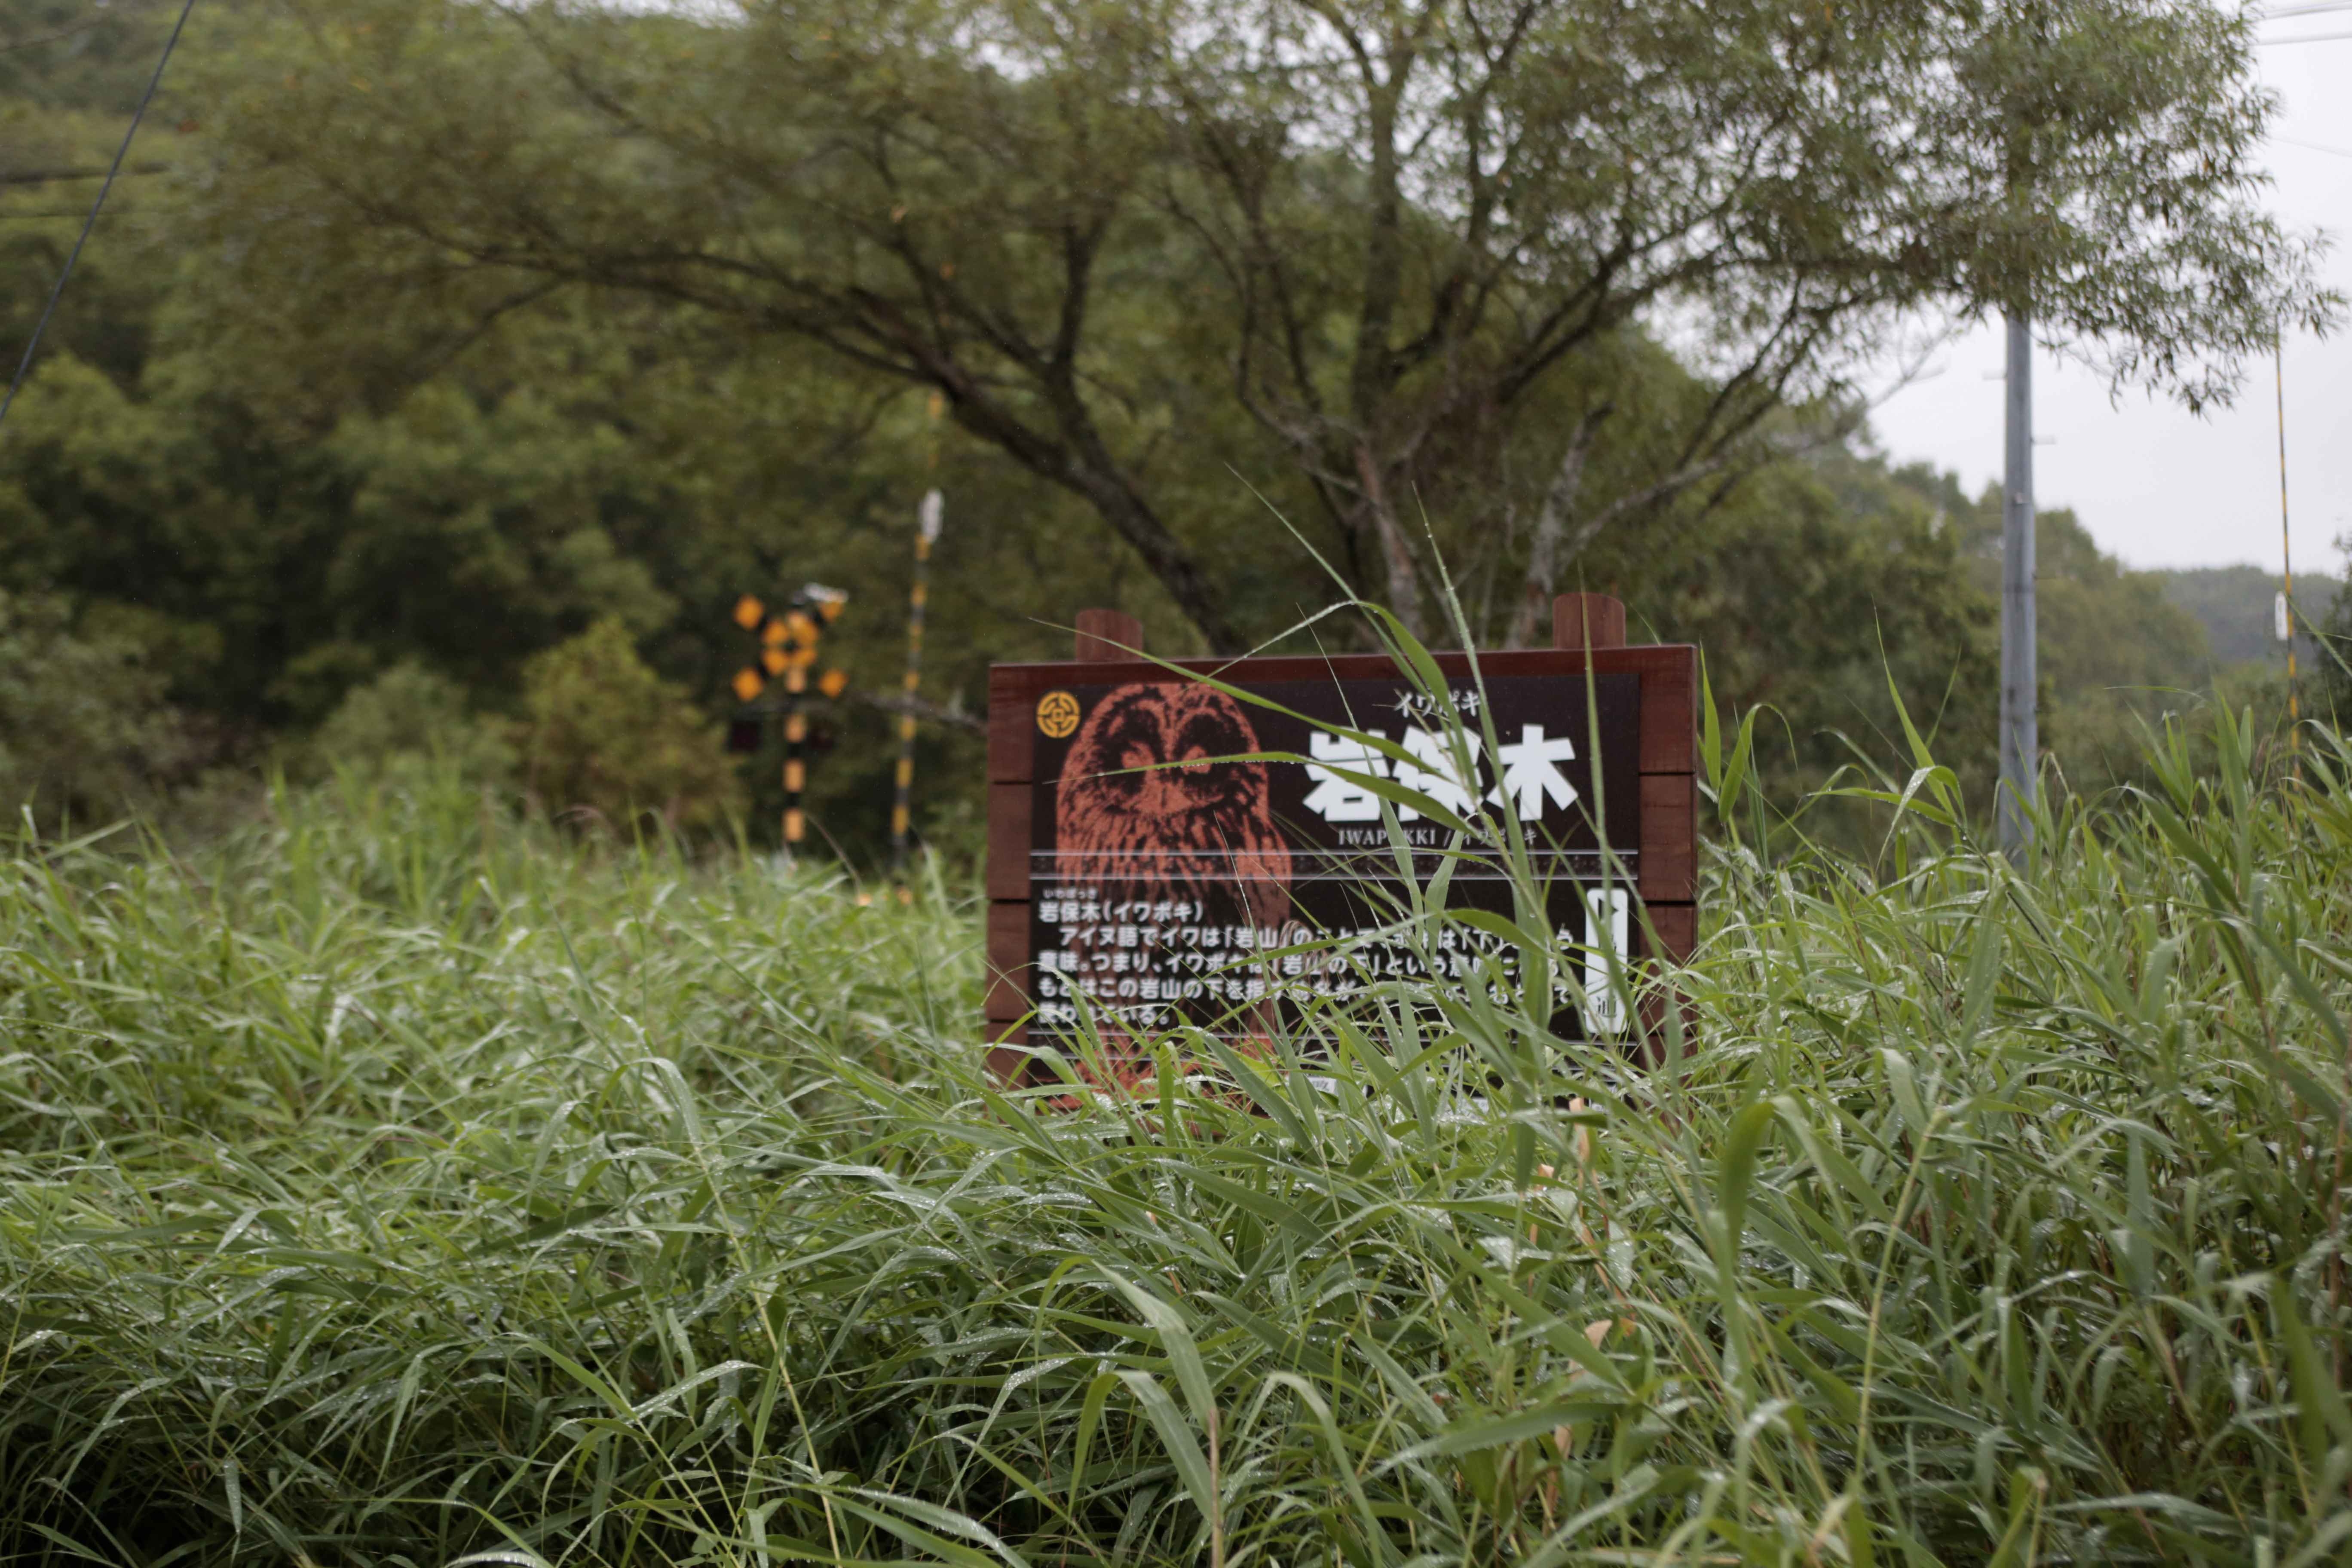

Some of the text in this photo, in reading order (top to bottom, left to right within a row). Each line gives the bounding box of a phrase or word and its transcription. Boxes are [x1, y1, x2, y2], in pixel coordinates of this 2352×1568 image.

[1302, 723, 1578, 822] 岩保木
[1338, 828, 1436, 846] IWAPKKI
